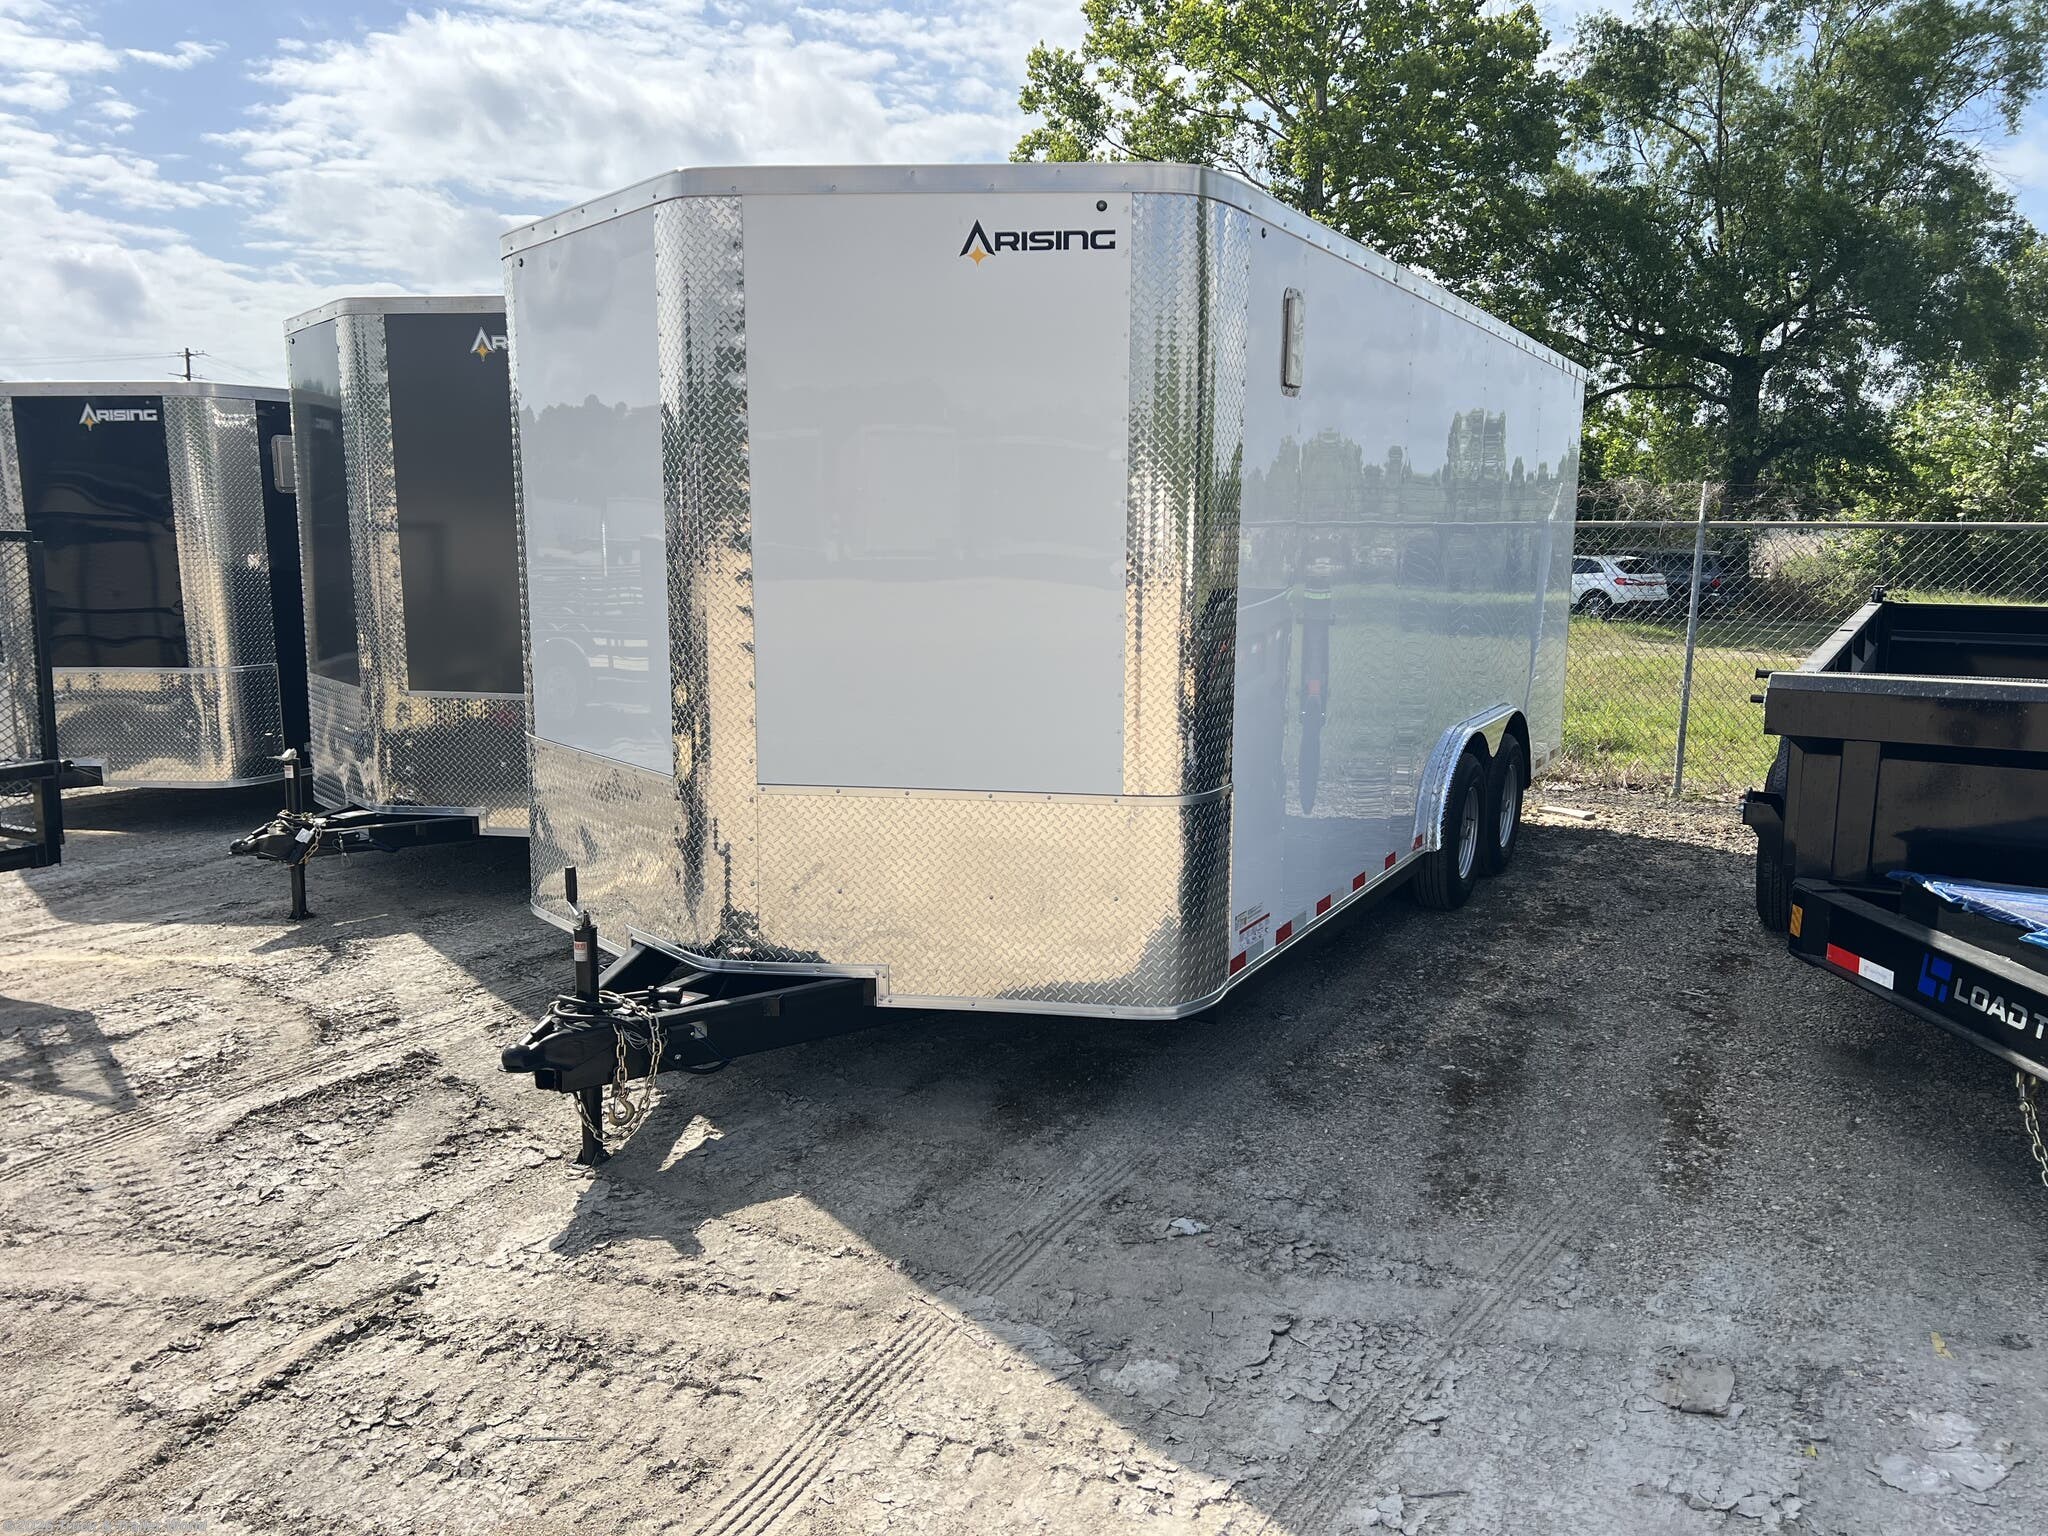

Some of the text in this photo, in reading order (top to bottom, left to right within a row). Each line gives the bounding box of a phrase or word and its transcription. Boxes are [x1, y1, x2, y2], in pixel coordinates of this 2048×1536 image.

[959, 219, 1116, 257] ARISING
[79, 402, 158, 425] ARISING
[1953, 978, 2029, 1030] LOAD
